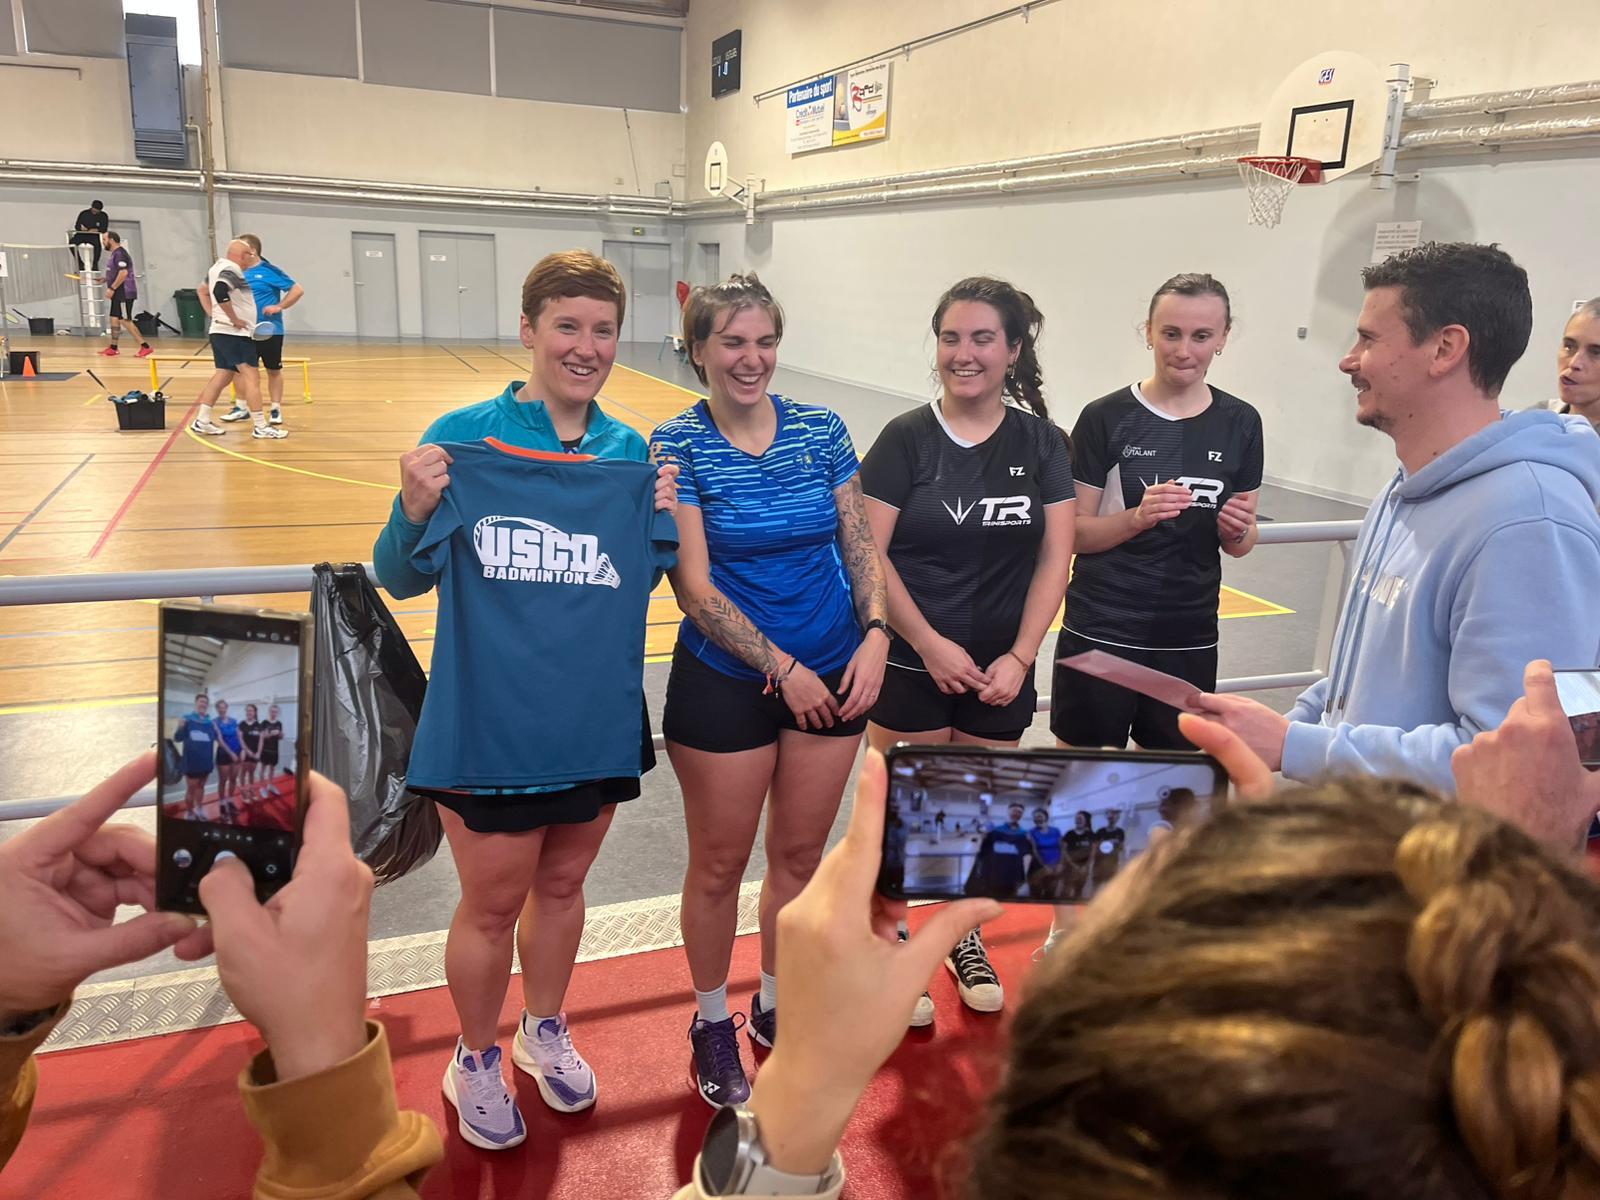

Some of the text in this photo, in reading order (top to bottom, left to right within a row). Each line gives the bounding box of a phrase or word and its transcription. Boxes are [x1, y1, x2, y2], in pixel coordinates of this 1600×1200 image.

[788, 78, 833, 104] Partenaire du sport
[1130, 449, 1156, 457] TALANT
[1208, 450, 1222, 462] FZ
[1009, 466, 1025, 476] FZ
[978, 495, 1031, 521] TR
[482, 566, 584, 585] BADMINTON
